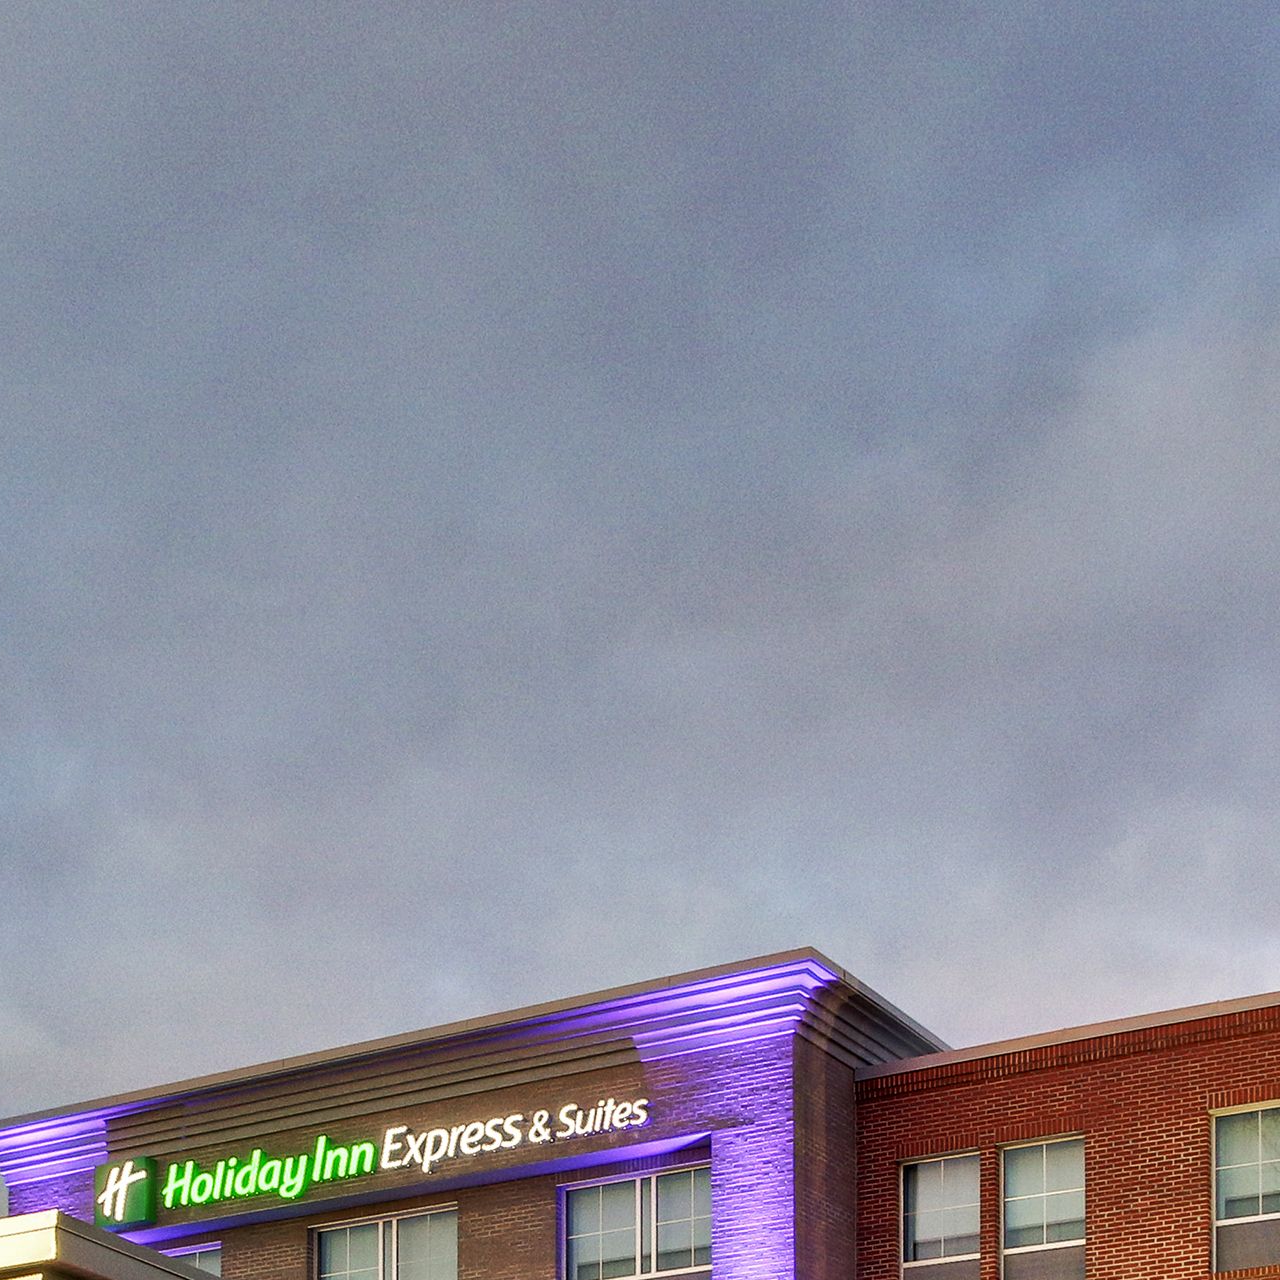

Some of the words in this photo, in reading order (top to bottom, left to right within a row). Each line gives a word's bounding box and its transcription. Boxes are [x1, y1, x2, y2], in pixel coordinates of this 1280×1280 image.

[162, 1148, 309, 1208] Holiday
[310, 1135, 377, 1182] Inn
[380, 1114, 523, 1173] Express
[527, 1109, 552, 1143] &
[555, 1097, 650, 1139] Suites
